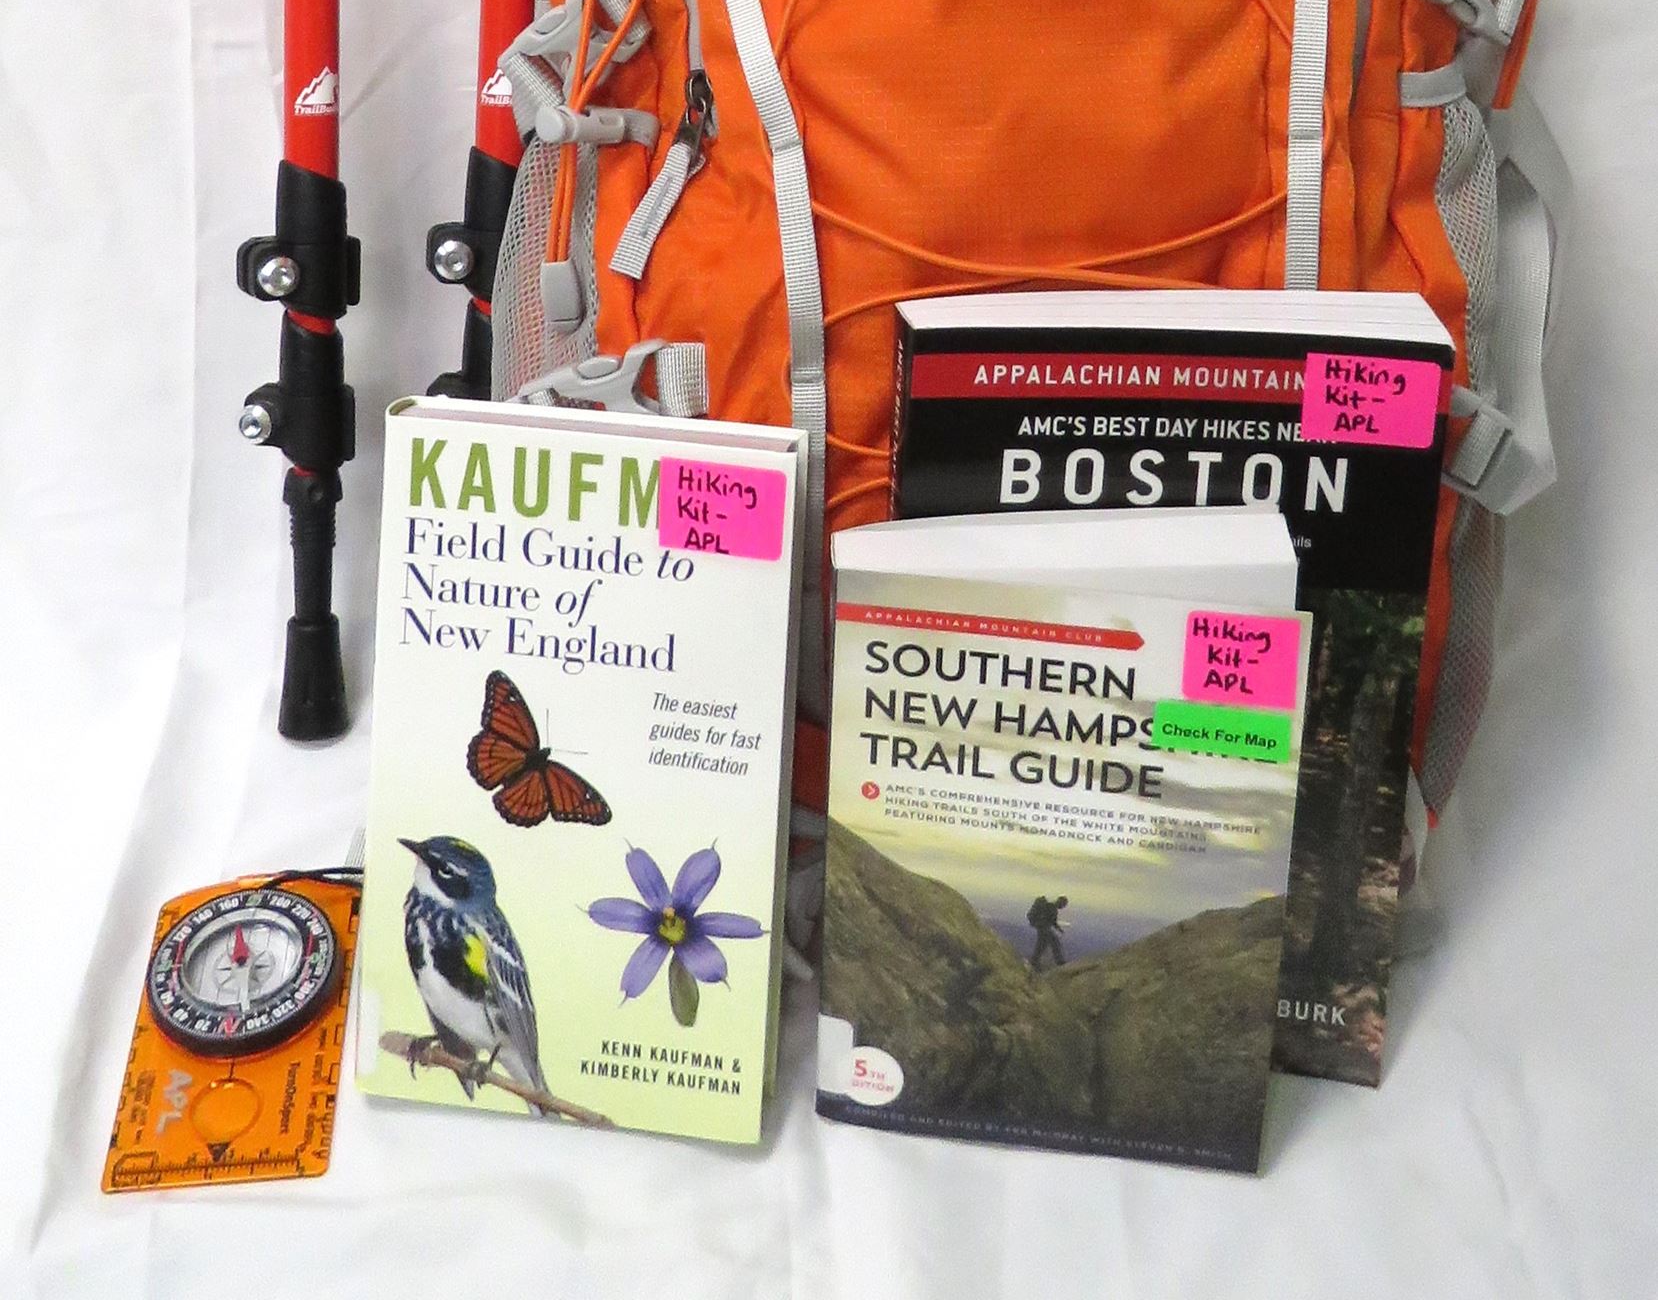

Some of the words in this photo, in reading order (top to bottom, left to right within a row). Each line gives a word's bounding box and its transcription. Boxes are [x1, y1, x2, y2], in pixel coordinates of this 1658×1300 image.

[974, 364, 1161, 386] APPALACHIAN
[1173, 367, 1305, 391] MOUNTAIN
[1325, 358, 1406, 395] Hiking
[1092, 416, 1150, 437] BEST
[1155, 417, 1199, 438] DAY
[1203, 419, 1270, 441] HIKES
[1333, 412, 1380, 434] APL
[409, 437, 660, 530] KAUFM
[678, 465, 758, 509] Hiking
[1000, 448, 1349, 513] BOSTON
[404, 516, 508, 563] Field
[522, 527, 644, 577] Guide
[657, 550, 694, 582] to
[684, 526, 730, 555] APL
[401, 561, 540, 612] Nature
[555, 578, 603, 628] of
[399, 606, 492, 652] New
[504, 615, 677, 675] England
[865, 611, 971, 629] APPALACHIAN
[979, 621, 1057, 638] MOUNTAIN
[1192, 617, 1271, 654] Hiking
[865, 639, 1136, 701] SOUTHERN
[1203, 668, 1254, 694] APL
[652, 691, 679, 713] The
[682, 699, 738, 721] easiest
[864, 686, 978, 731] NEW
[649, 721, 701, 743] guides
[705, 725, 728, 746] for
[730, 729, 762, 751] fast
[1162, 723, 1210, 740] Check
[1215, 729, 1241, 744] For
[1245, 733, 1277, 750] Map
[648, 747, 749, 776] identification
[860, 731, 996, 780] TRAIL
[1010, 749, 1164, 800] GUIDE
[1276, 999, 1346, 1027] BURK
[601, 1039, 642, 1059] KENN
[650, 1046, 723, 1071] KAUFMAN
[732, 1058, 742, 1073] &
[580, 1059, 659, 1084] KIMBERLY
[667, 1070, 741, 1095] KAUFMAN
